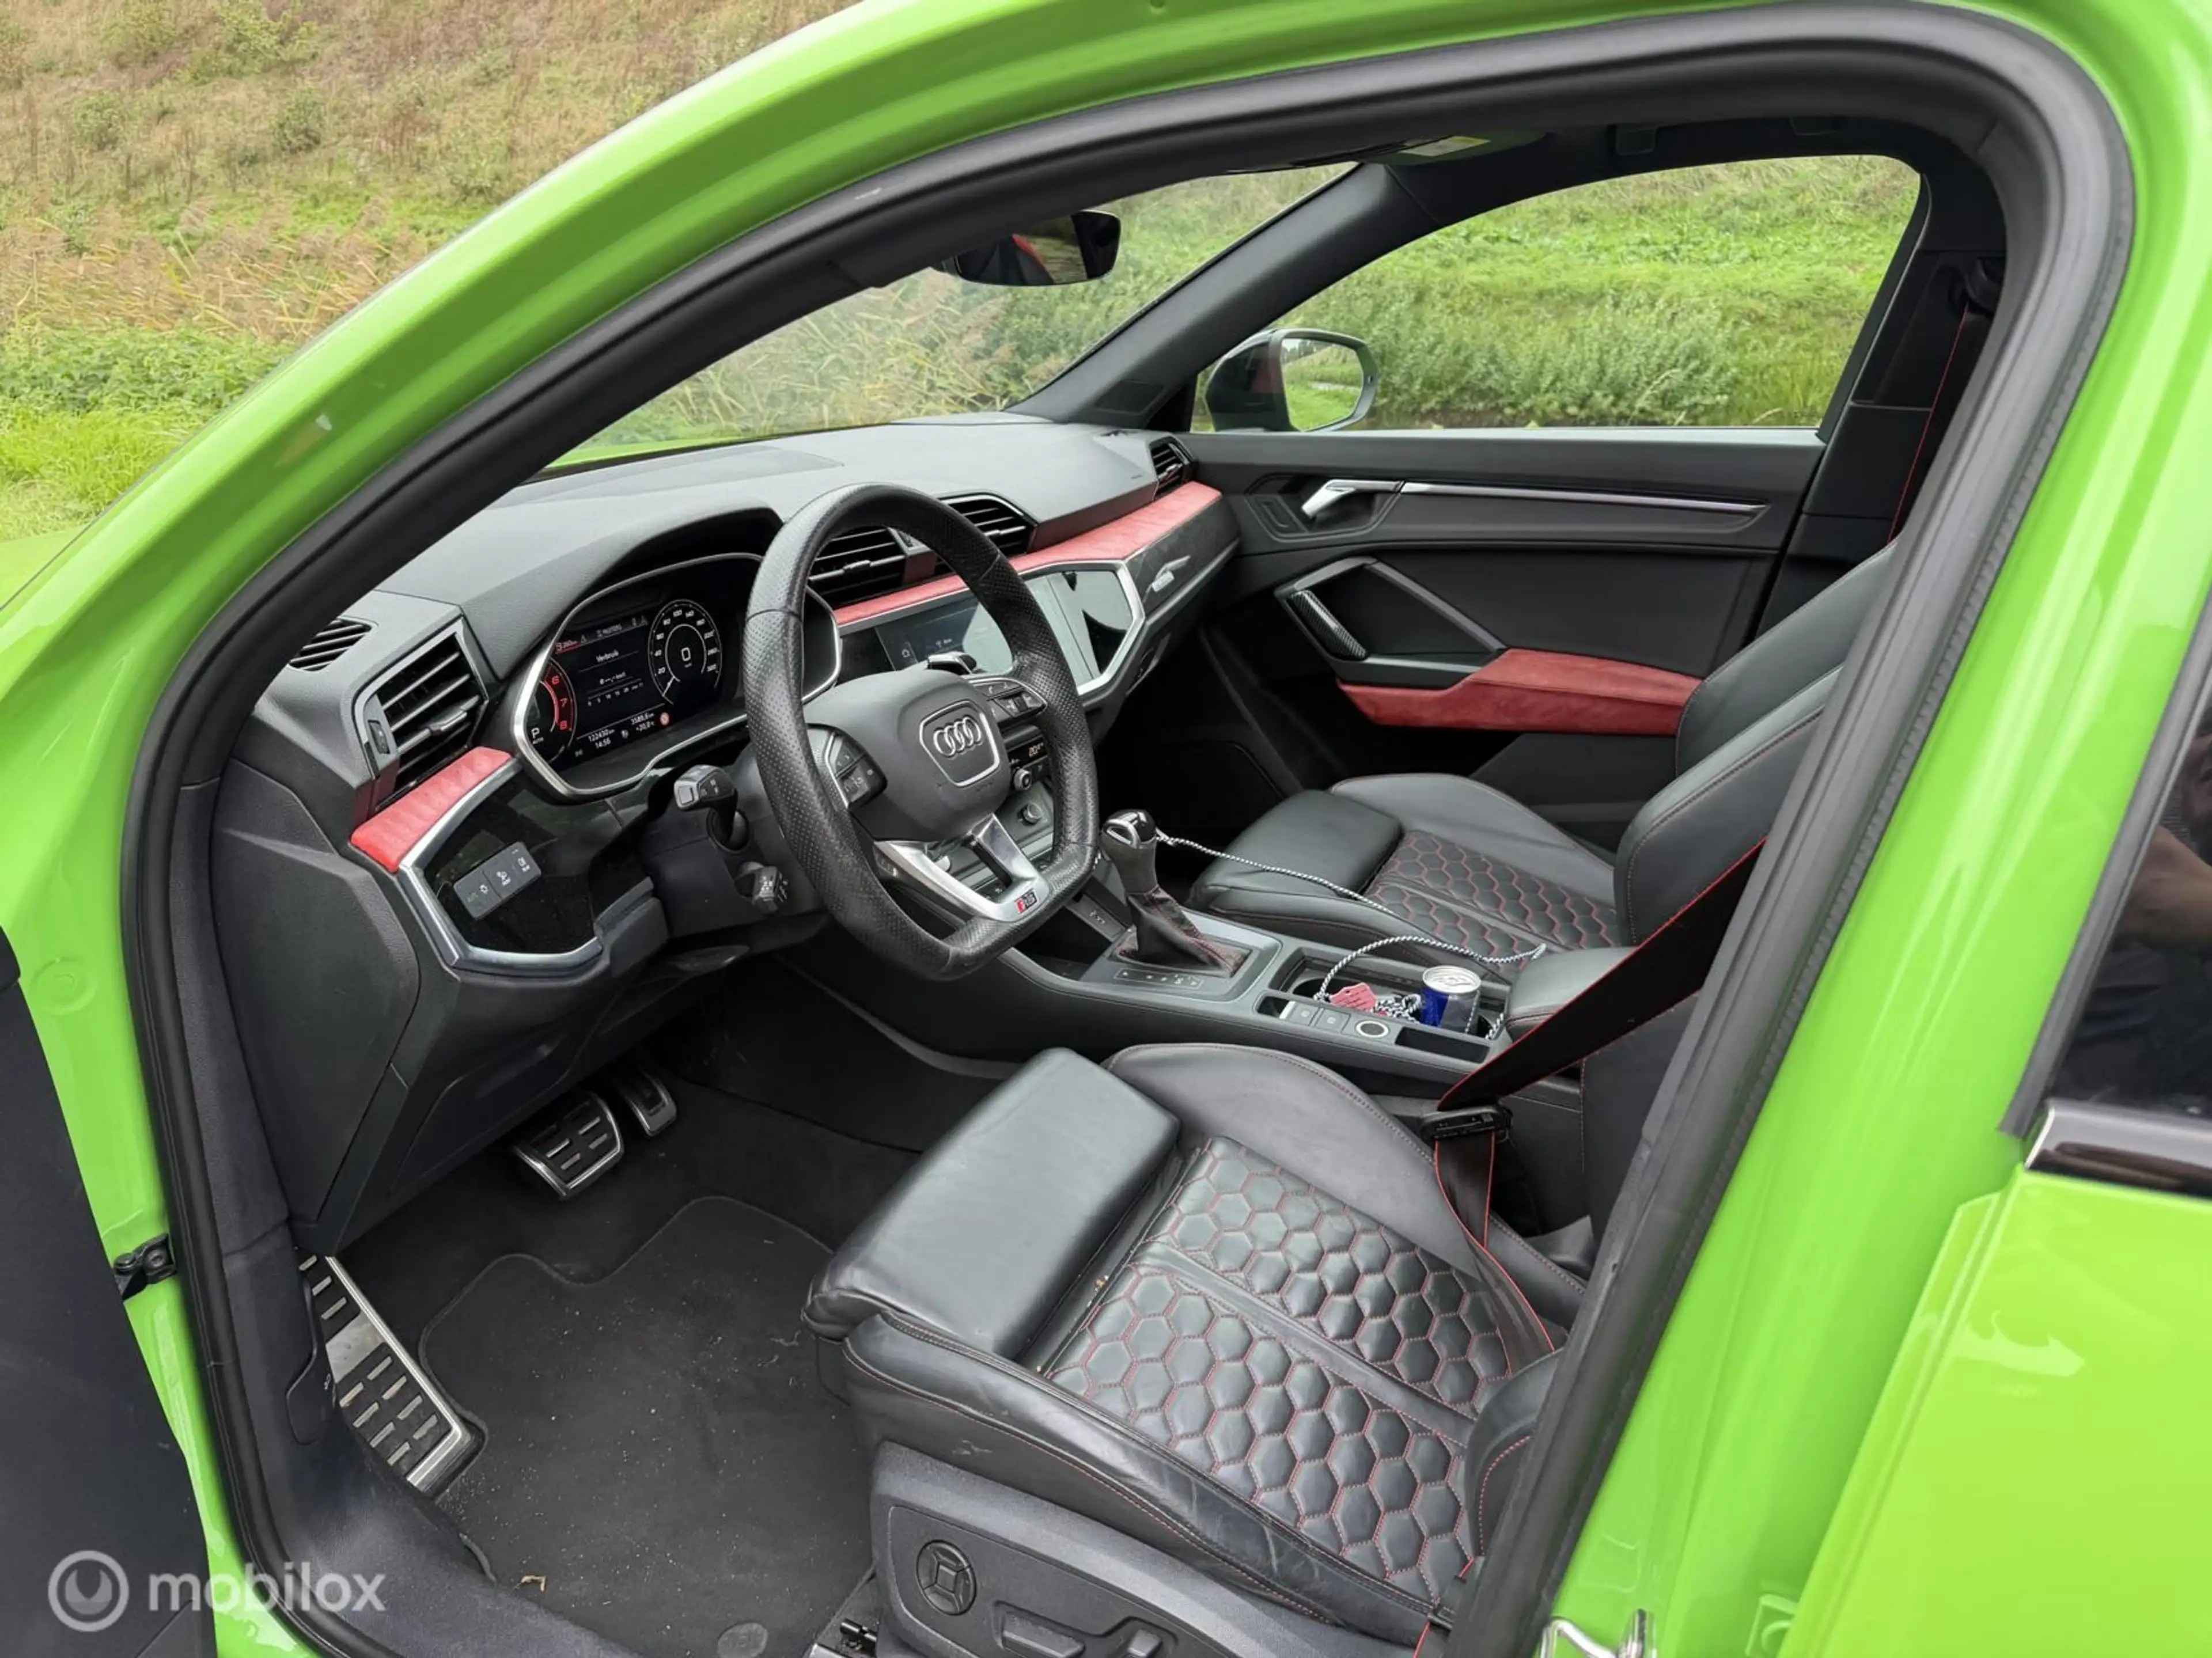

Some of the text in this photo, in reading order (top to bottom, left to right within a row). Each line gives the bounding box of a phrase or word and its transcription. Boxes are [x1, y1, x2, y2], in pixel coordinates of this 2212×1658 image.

[681, 647, 691, 662] 0
[551, 674, 560, 685] 6
[559, 697, 568, 707] 7
[559, 720, 567, 730] 8
[531, 727, 540, 739] P
